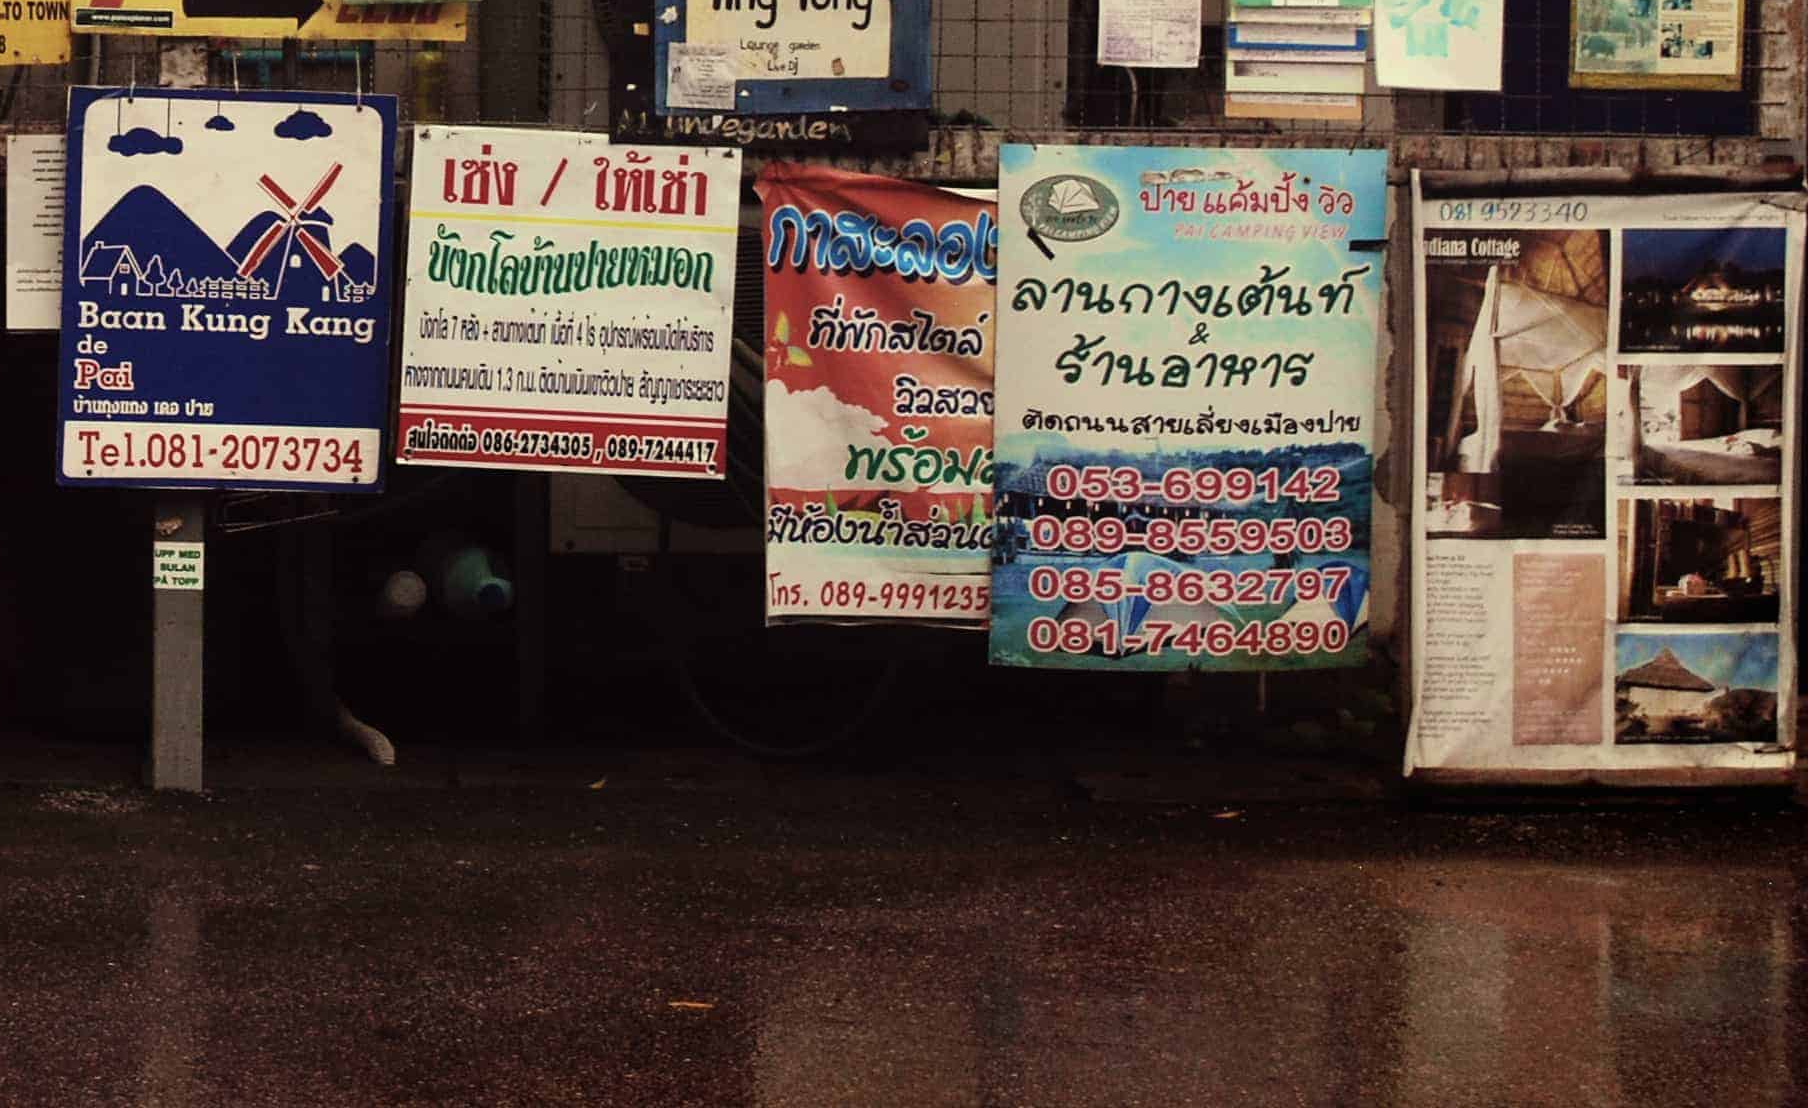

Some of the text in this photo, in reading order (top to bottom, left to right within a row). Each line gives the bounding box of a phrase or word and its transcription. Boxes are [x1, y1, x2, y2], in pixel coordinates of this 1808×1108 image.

[27, 1, 69, 21] TOWN
[540, 158, 568, 207] /
[593, 150, 708, 216] ให้เช่า
[1140, 171, 1354, 216] ปาย แค้มปิ้ง วิว
[1440, 202, 1473, 222] 081
[1175, 223, 1349, 241] PAI CAMPING VIEW
[1470, 237, 1521, 258] Cottage
[428, 223, 713, 296] บังกโลบ้านปายหมอก
[1010, 265, 1370, 319] ลานกางเต้นท์
[78, 301, 376, 343] Baan Kung Kang
[452, 316, 457, 340] 7
[809, 296, 989, 357] ที่พักสไตล์
[1188, 322, 1211, 346] &
[77, 335, 108, 356] de
[1054, 333, 1316, 389] ร้านอาหาร
[74, 358, 134, 391] Pai
[498, 367, 513, 392] 1.3
[185, 399, 214, 416] ปาย
[1021, 404, 1362, 436] ติดถนนสายเลี่ยงเมืองปาย
[78, 431, 363, 474] Tel.081-2073734
[407, 418, 715, 467] สนใจติดต่อ 086-2734305 089-7244417
[1046, 464, 1343, 503] 053-699142
[1030, 516, 1353, 554] 089-8559503
[179, 550, 200, 559] MED
[171, 577, 199, 585] TOPP
[820, 580, 990, 612] 089-9991235
[1028, 566, 1352, 605] 085-8632797
[1028, 617, 1351, 656] 081-7464890
